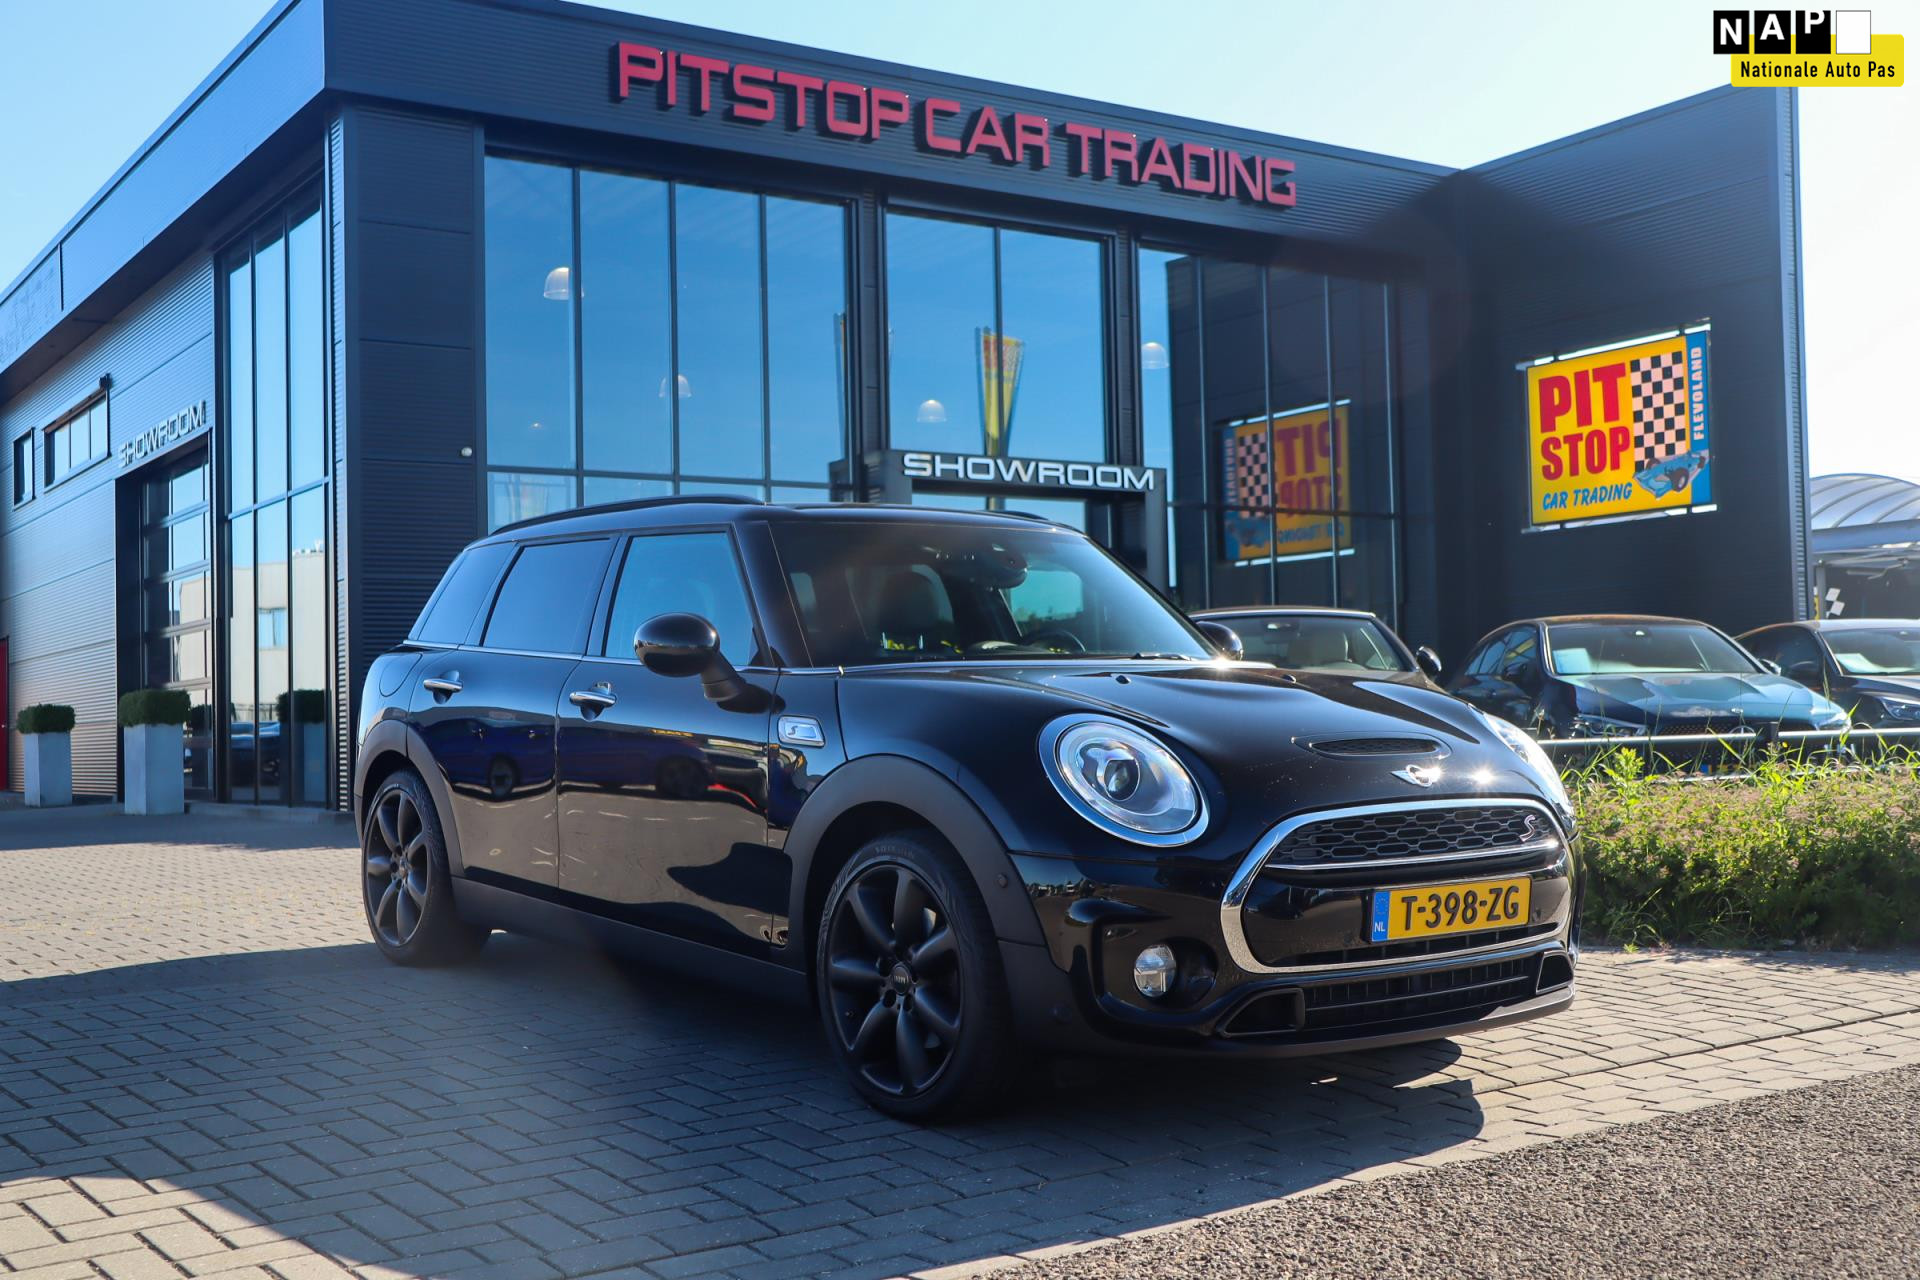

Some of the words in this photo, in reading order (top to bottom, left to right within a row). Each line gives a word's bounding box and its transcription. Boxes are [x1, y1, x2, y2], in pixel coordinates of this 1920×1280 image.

[619, 41, 910, 139] PITSTOP
[924, 97, 1051, 167] CAR
[1066, 121, 1297, 207] TRADING
[1538, 362, 1627, 434] PIT
[1690, 347, 1705, 441] FLEVOLAND
[117, 399, 207, 469] SHOWROOM
[1540, 425, 1631, 481] STOP
[902, 452, 1155, 491] SHOWROOM
[1542, 488, 1568, 511] CAR
[1572, 481, 1633, 507] TRADING
[1374, 921, 1386, 933] NL
[1401, 885, 1520, 931] T-398-ZG
